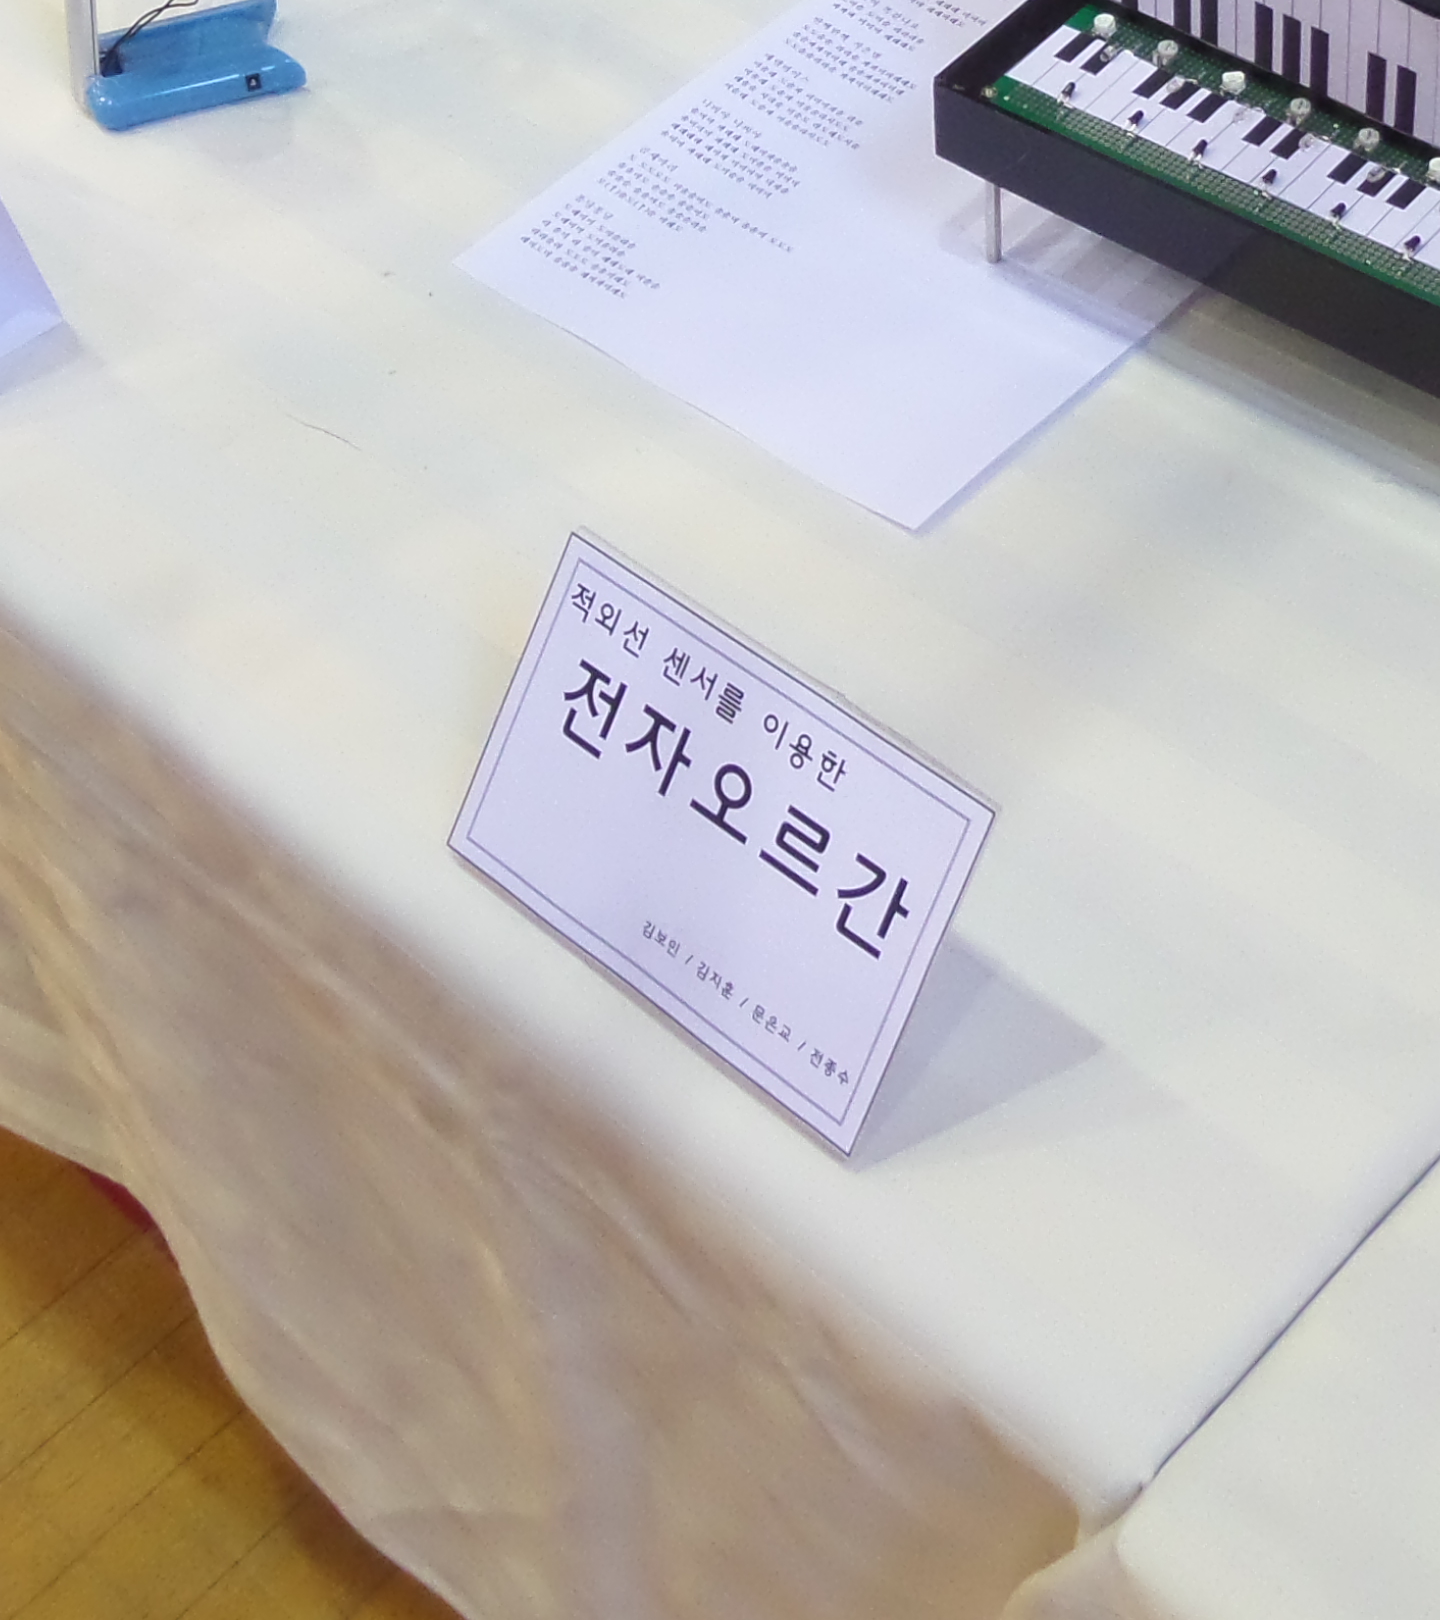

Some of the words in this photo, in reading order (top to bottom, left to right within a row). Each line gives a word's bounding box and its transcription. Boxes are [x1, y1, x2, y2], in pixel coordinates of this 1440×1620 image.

[569, 582, 651, 659] 적외선
[662, 645, 745, 725] 센서를
[762, 712, 849, 793] 이용한
[560, 658, 911, 959] 전자오르간
[695, 960, 735, 1000] 김지훈
[808, 1046, 850, 1086] 전종수
